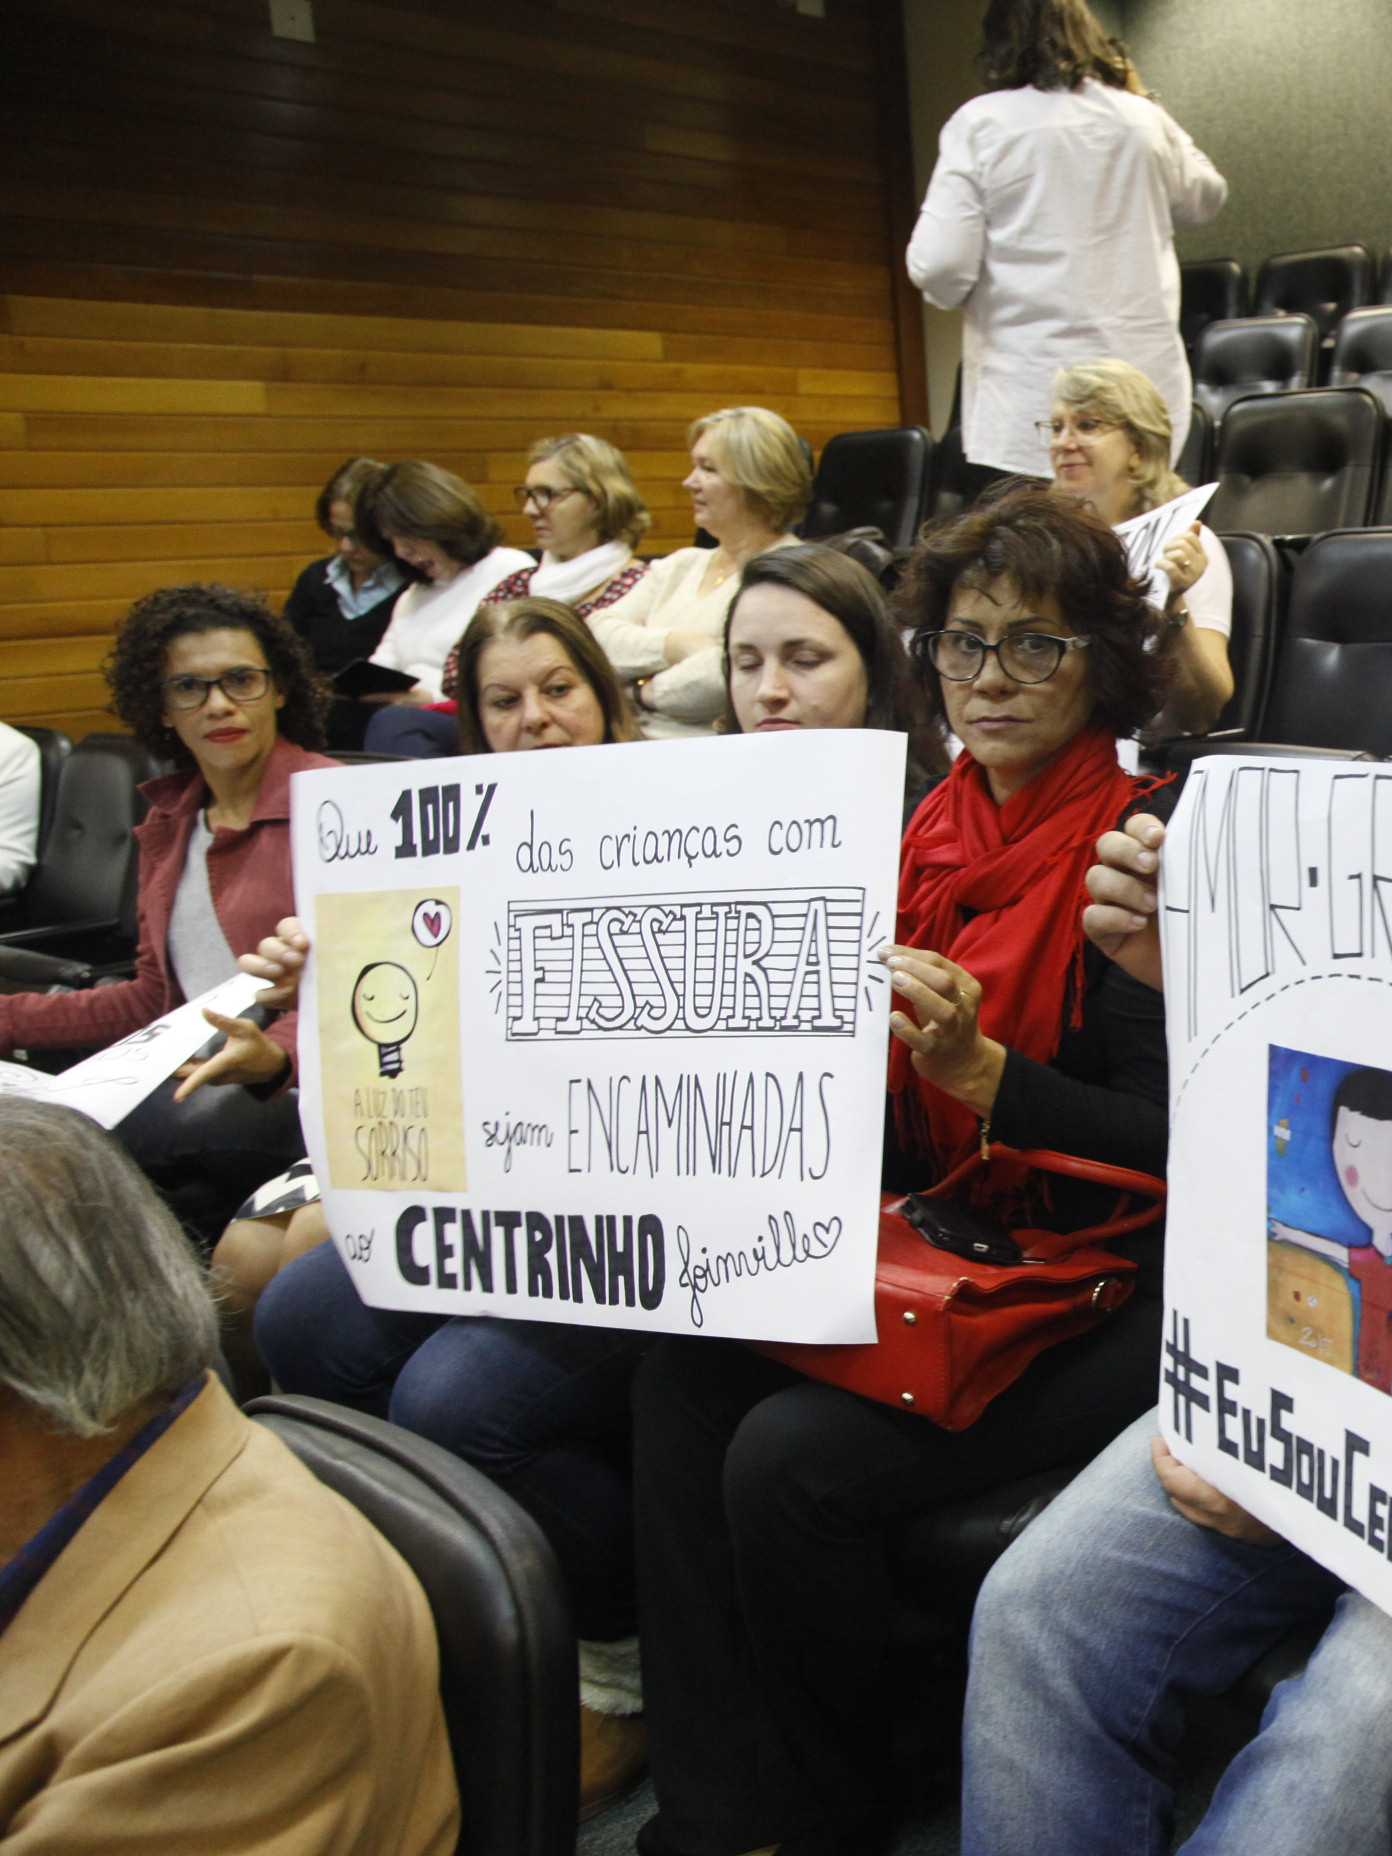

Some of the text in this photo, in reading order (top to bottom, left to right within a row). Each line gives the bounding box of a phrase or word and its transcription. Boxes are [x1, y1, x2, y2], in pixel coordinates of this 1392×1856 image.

[317, 782, 842, 873] Que 100% das crianças com
[511, 897, 843, 1035] FISSURA
[354, 1120, 430, 1182] SORRISO
[482, 1070, 834, 1181] sejam ENCAMINHADAS
[395, 1205, 666, 1310] CENTRINHO
